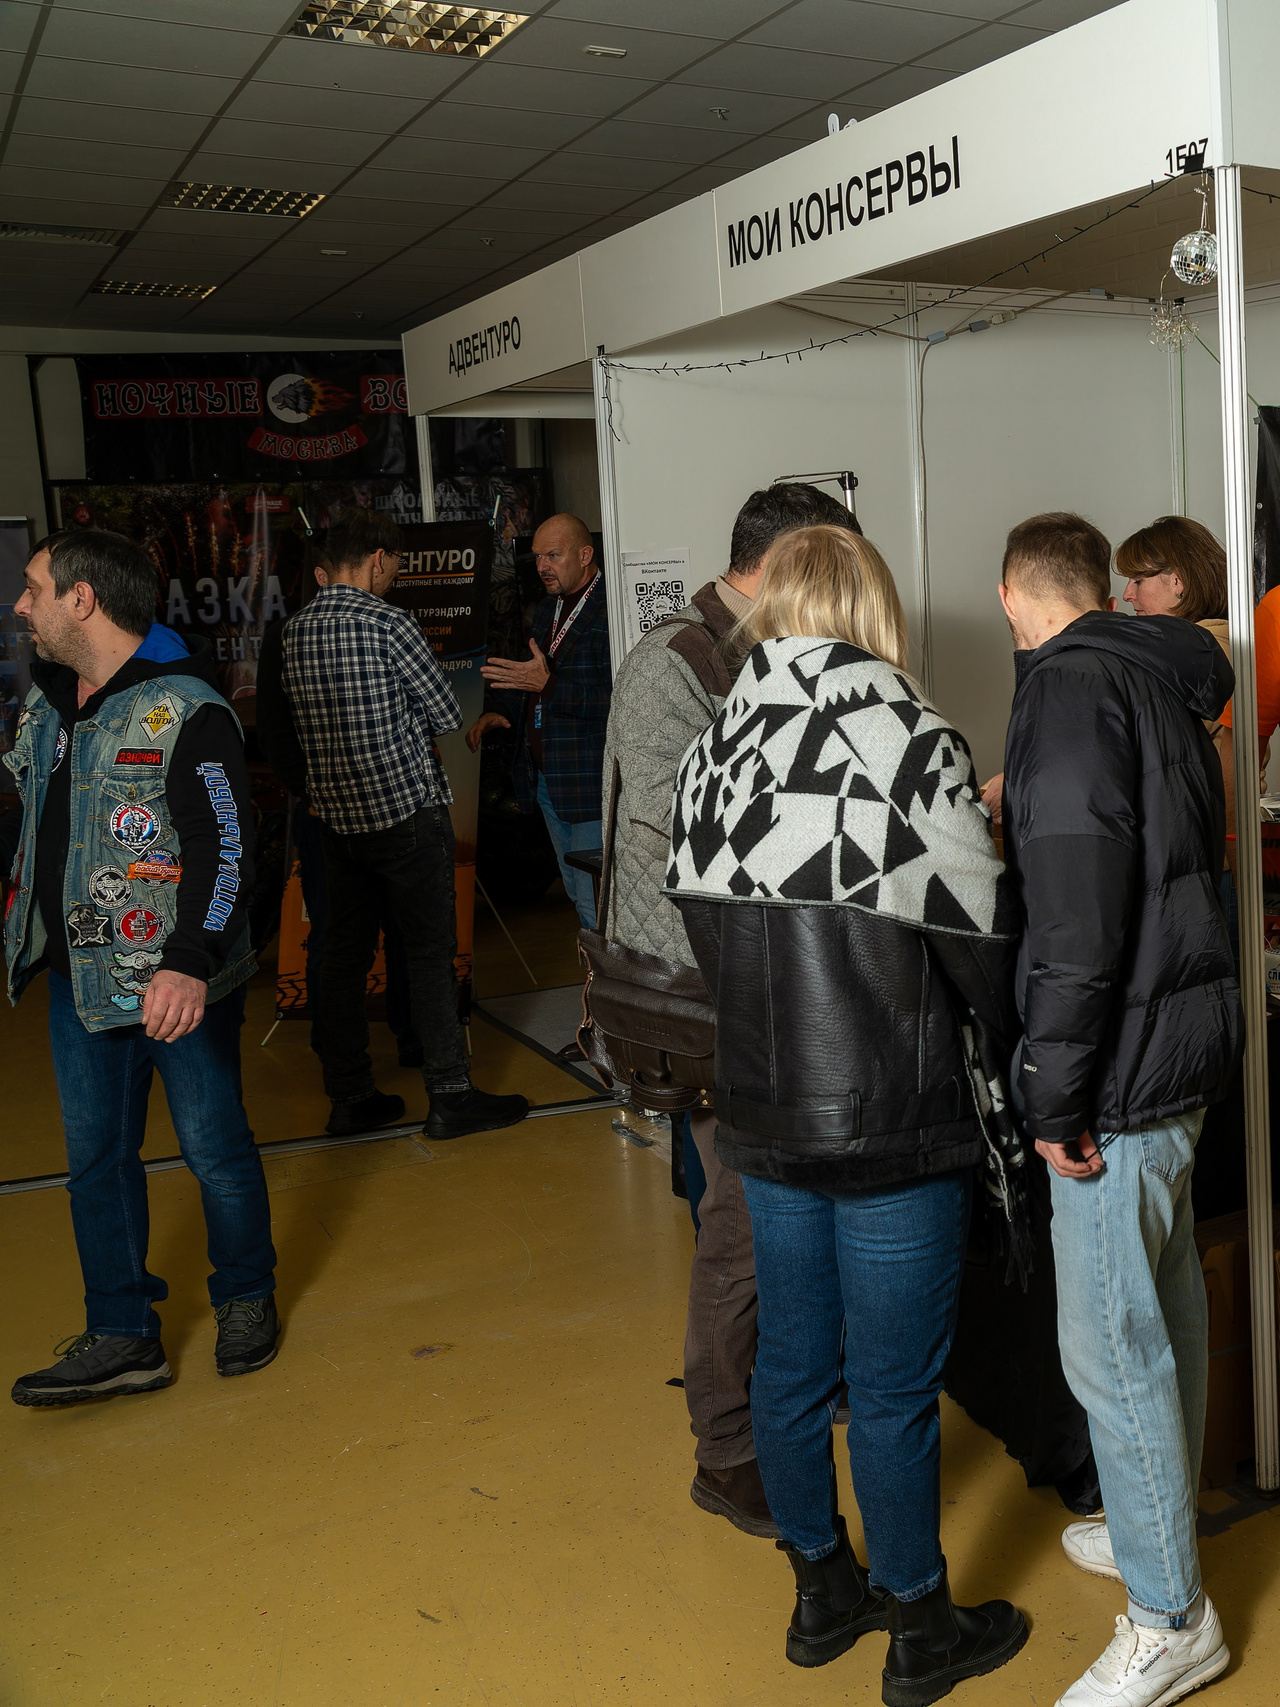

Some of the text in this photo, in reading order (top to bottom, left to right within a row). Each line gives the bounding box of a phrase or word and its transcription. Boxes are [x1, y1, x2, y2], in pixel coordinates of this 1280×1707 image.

[728, 134, 961, 268] МОИ КОНСЕРВЫ
[448, 315, 523, 377] АДВЕНТУРО
[94, 381, 261, 416] НОЧНЫЕ
[257, 430, 358, 459] МОСКВА
[418, 606, 472, 618] ТУРЭНДУРО
[438, 660, 473, 671] НДУРО
